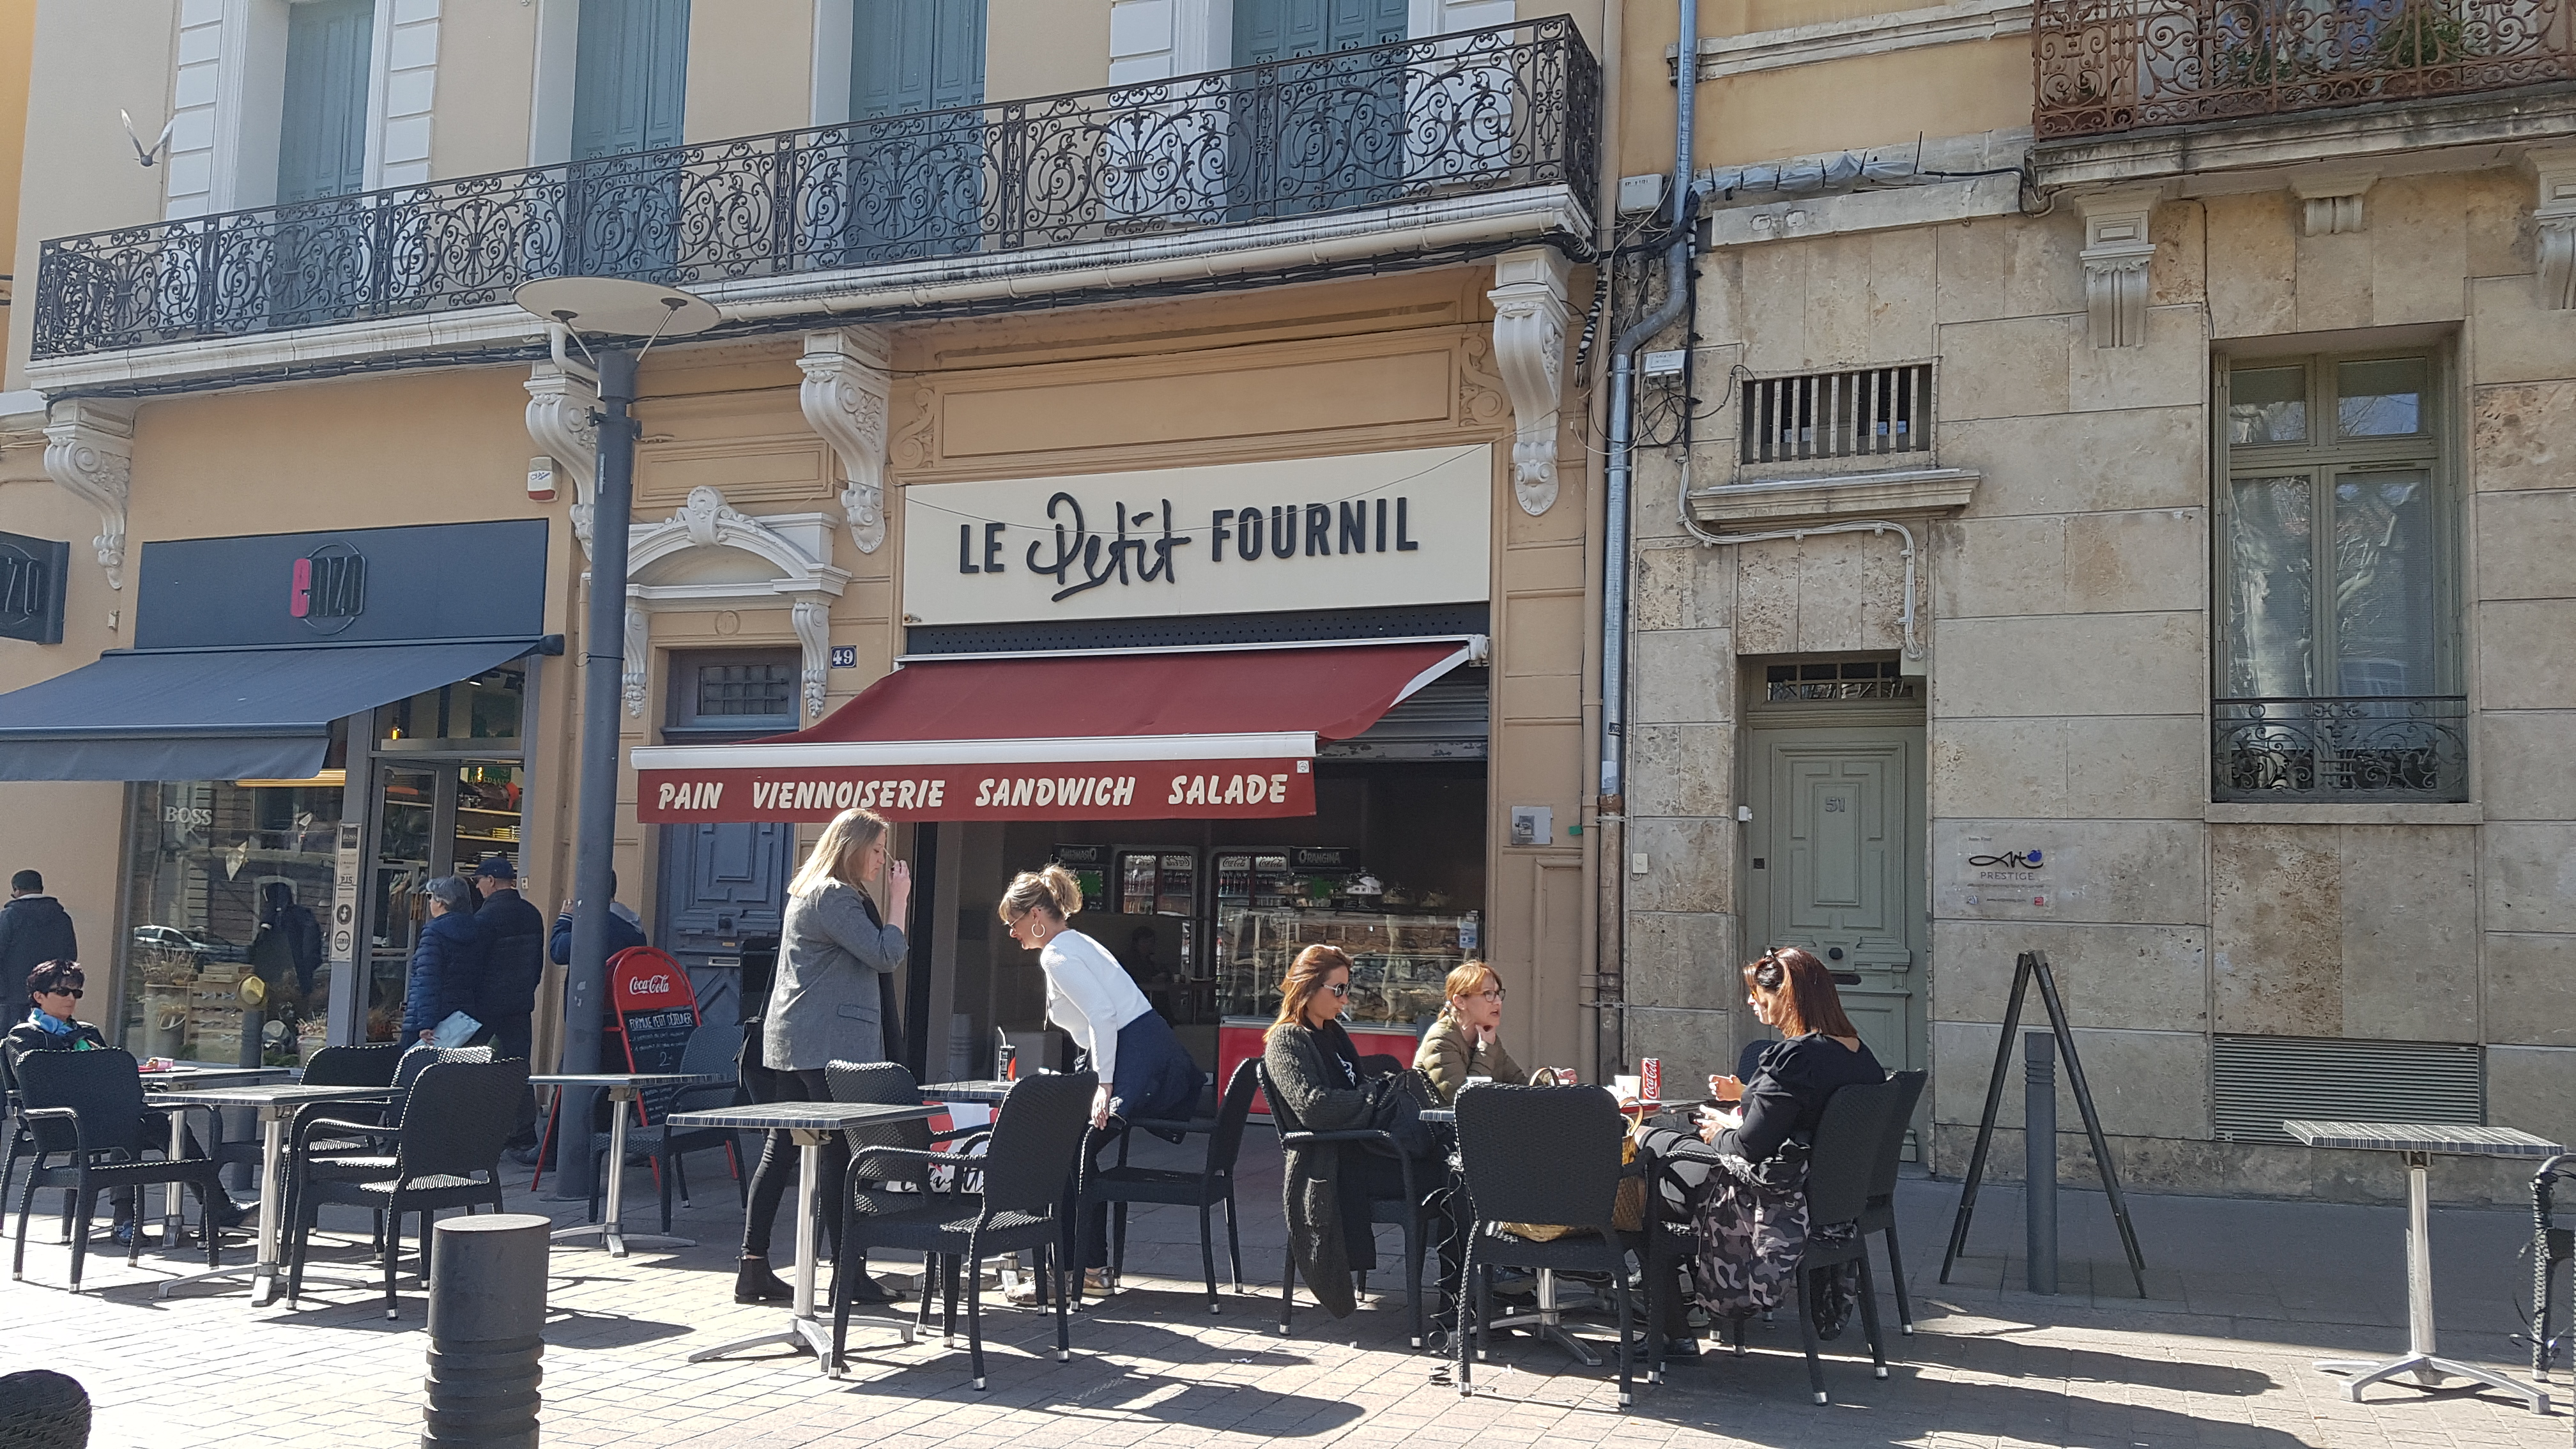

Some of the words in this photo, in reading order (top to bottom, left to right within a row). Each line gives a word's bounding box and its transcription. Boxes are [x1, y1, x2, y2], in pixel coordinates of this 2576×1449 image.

[960, 521, 1006, 574] LE
[1027, 491, 1192, 602] Petit
[1212, 497, 1419, 562] FOURNIL
[832, 649, 854, 665] 49
[658, 781, 723, 810] PAIN
[753, 779, 946, 809] VIENNOISERIE
[975, 776, 1136, 807] SANDWICH
[1168, 773, 1289, 806] SALADE
[1825, 797, 1846, 813] 51
[164, 806, 213, 826] BOSS
[1981, 871, 2035, 880] PRESTIGE
[629, 974, 670, 995] Coca-Cola
[1644, 1059, 1658, 1100] Coca-Cola
